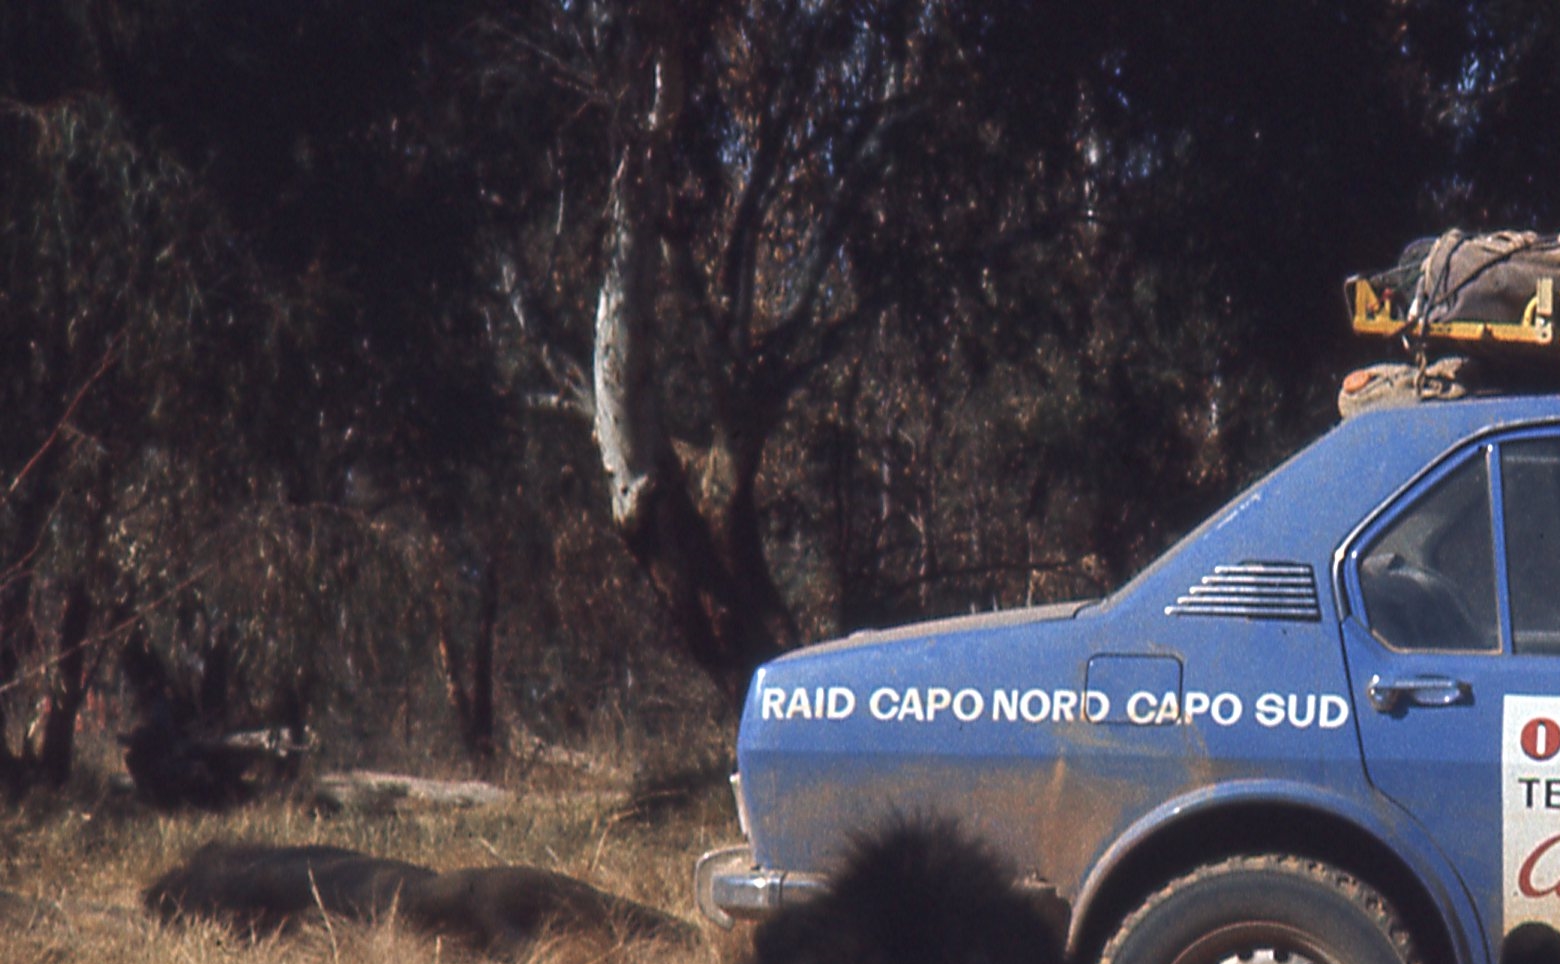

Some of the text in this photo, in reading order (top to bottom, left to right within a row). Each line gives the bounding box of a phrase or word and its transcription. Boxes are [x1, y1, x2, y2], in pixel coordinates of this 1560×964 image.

[761, 687, 1351, 728] RAID CAPO NORD CAPO SUD
